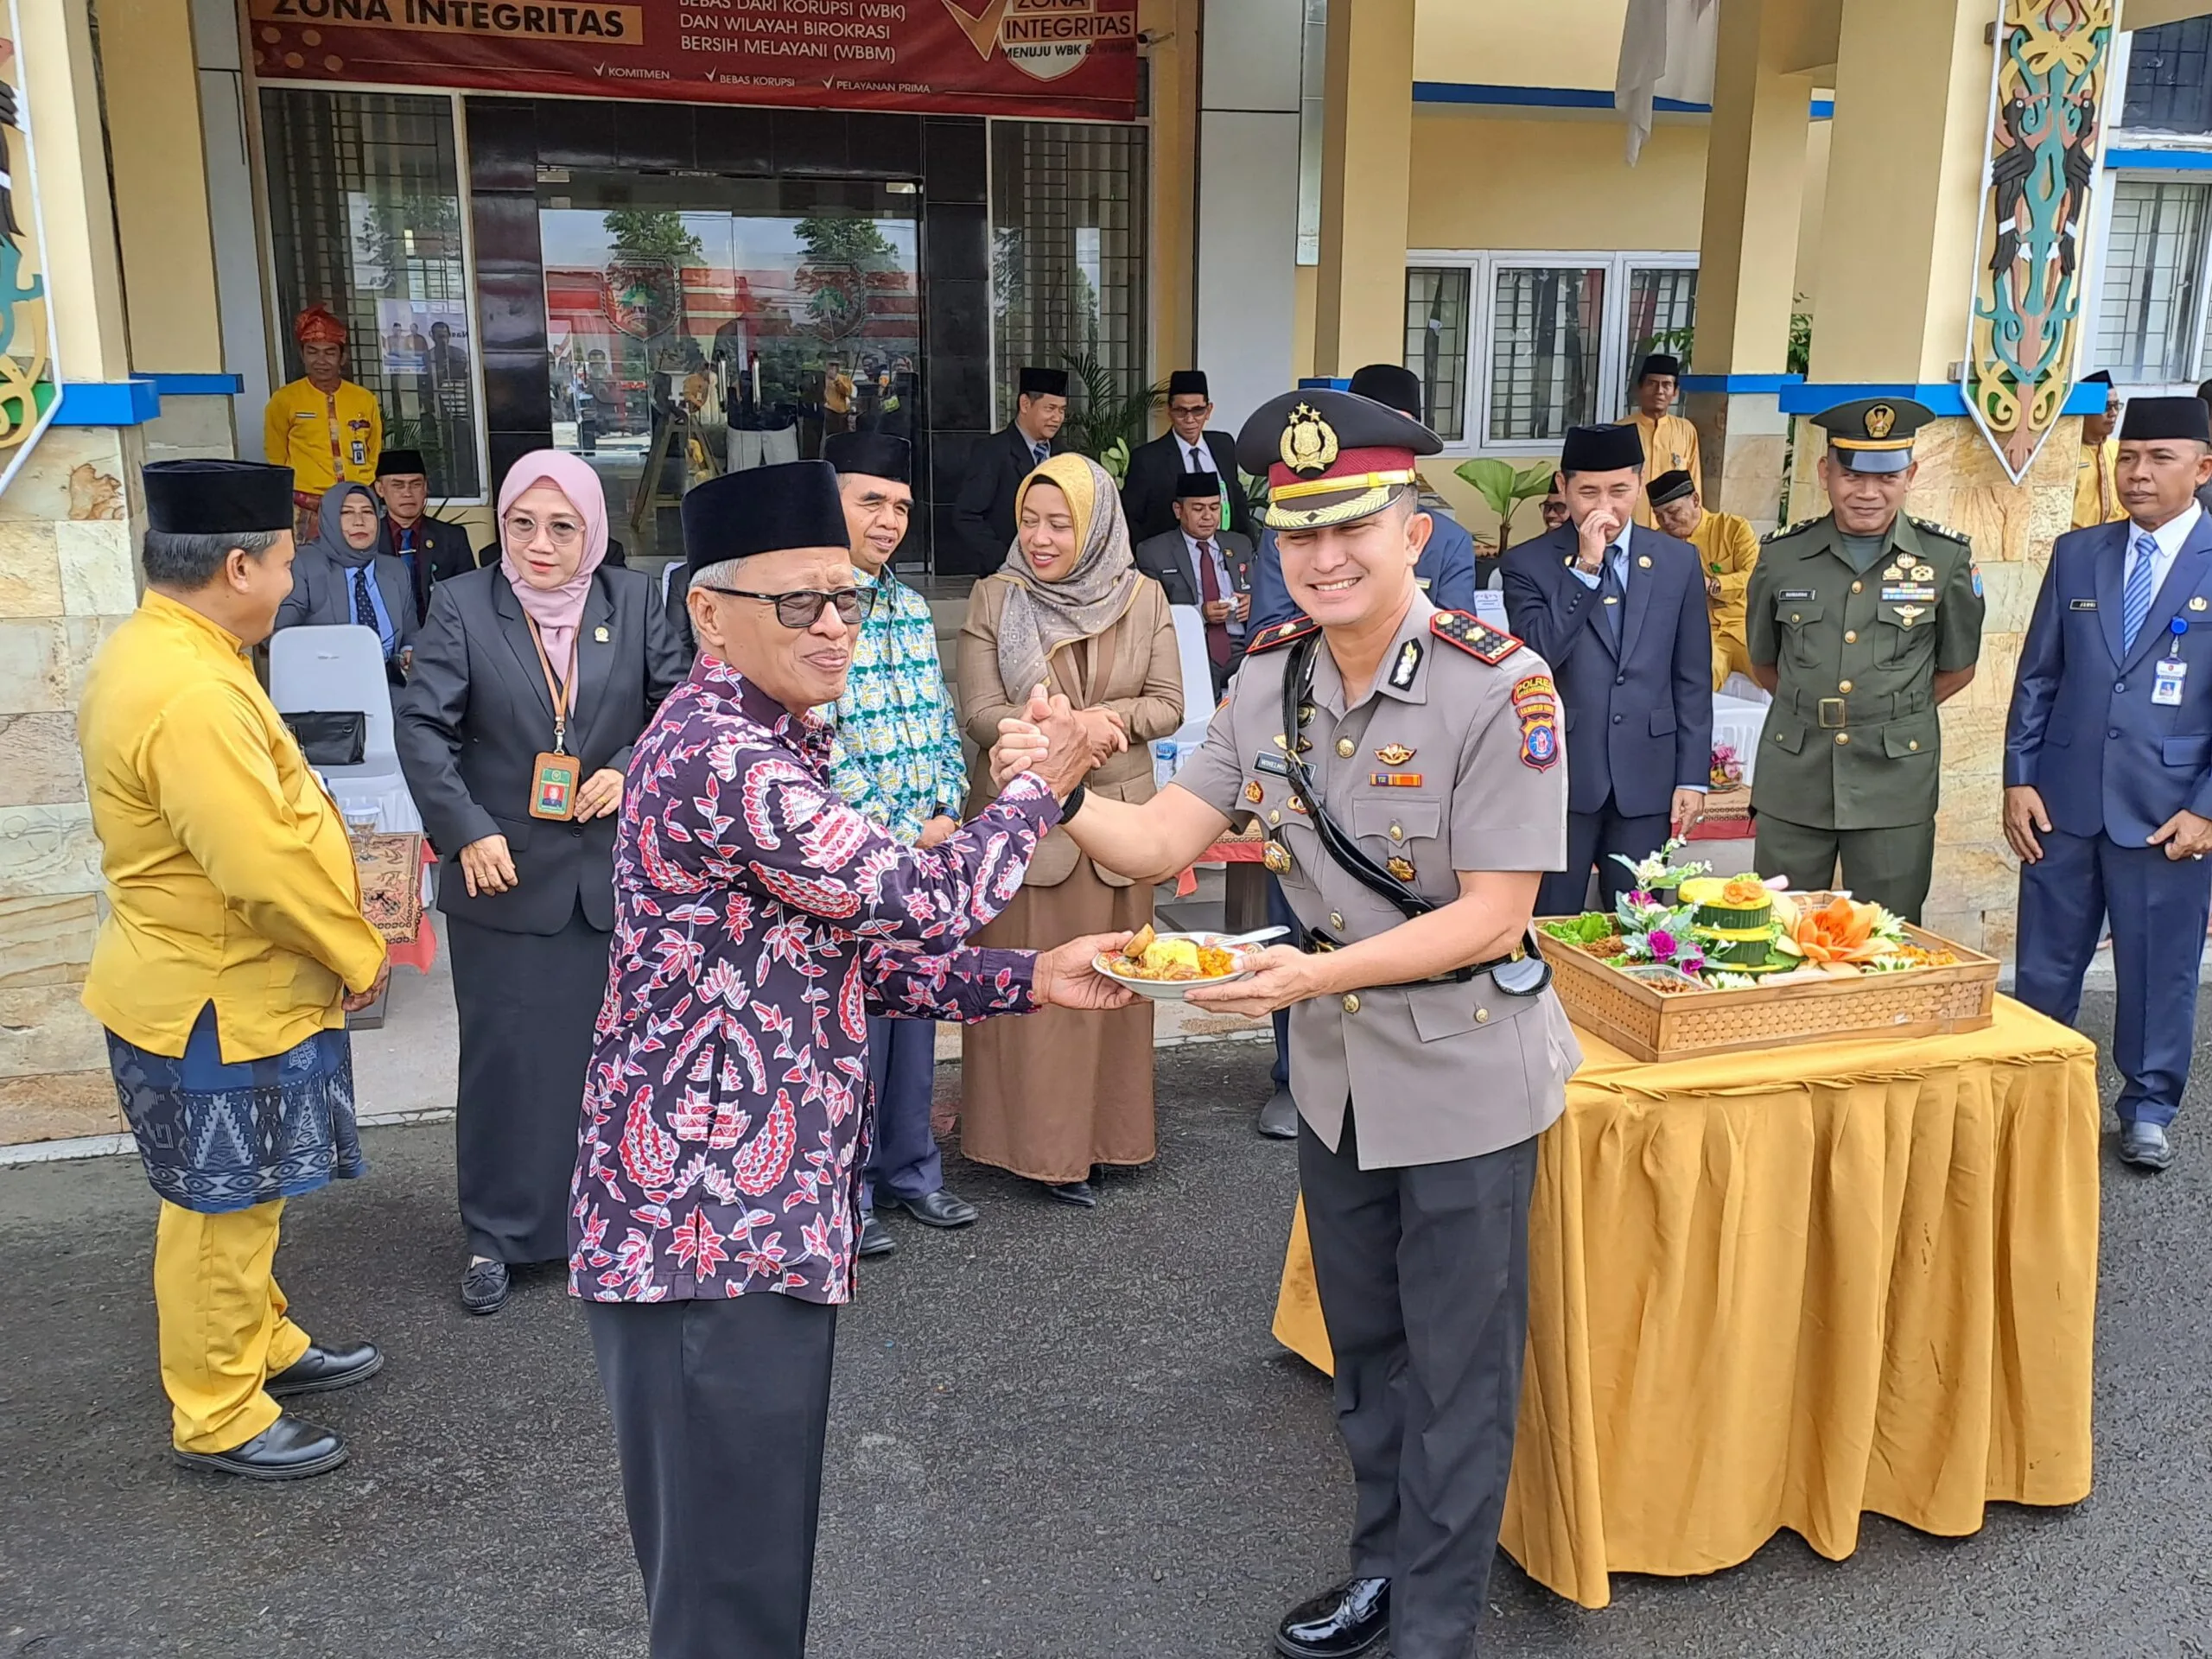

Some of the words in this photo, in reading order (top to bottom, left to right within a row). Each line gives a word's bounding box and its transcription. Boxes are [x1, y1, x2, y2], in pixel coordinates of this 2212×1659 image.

[272, 0, 392, 22] ZONA
[405, 0, 625, 38] INTEGRITAS
[737, 0, 777, 12] DARI
[783, 0, 854, 16] KORUPSI
[860, 3, 906, 22] (WBK)
[679, 13, 719, 30] DAN
[724, 16, 798, 35] WILAYAH
[804, 21, 890, 40] BIROKRASI
[1006, 16, 1131, 40] INTEGRITAS
[681, 35, 738, 53] BERSIH
[744, 38, 828, 57] MELAYANI
[833, 44, 896, 65] (WBBM)
[1001, 45, 1051, 59] MENUJU
[1055, 44, 1082, 56] WBK
[608, 67, 671, 80] KOMITMEN
[720, 74, 750, 85] BEBAS
[753, 76, 795, 87] KORUPSI
[836, 80, 895, 92] PELAYANAN
[899, 83, 931, 94] PRIMA
